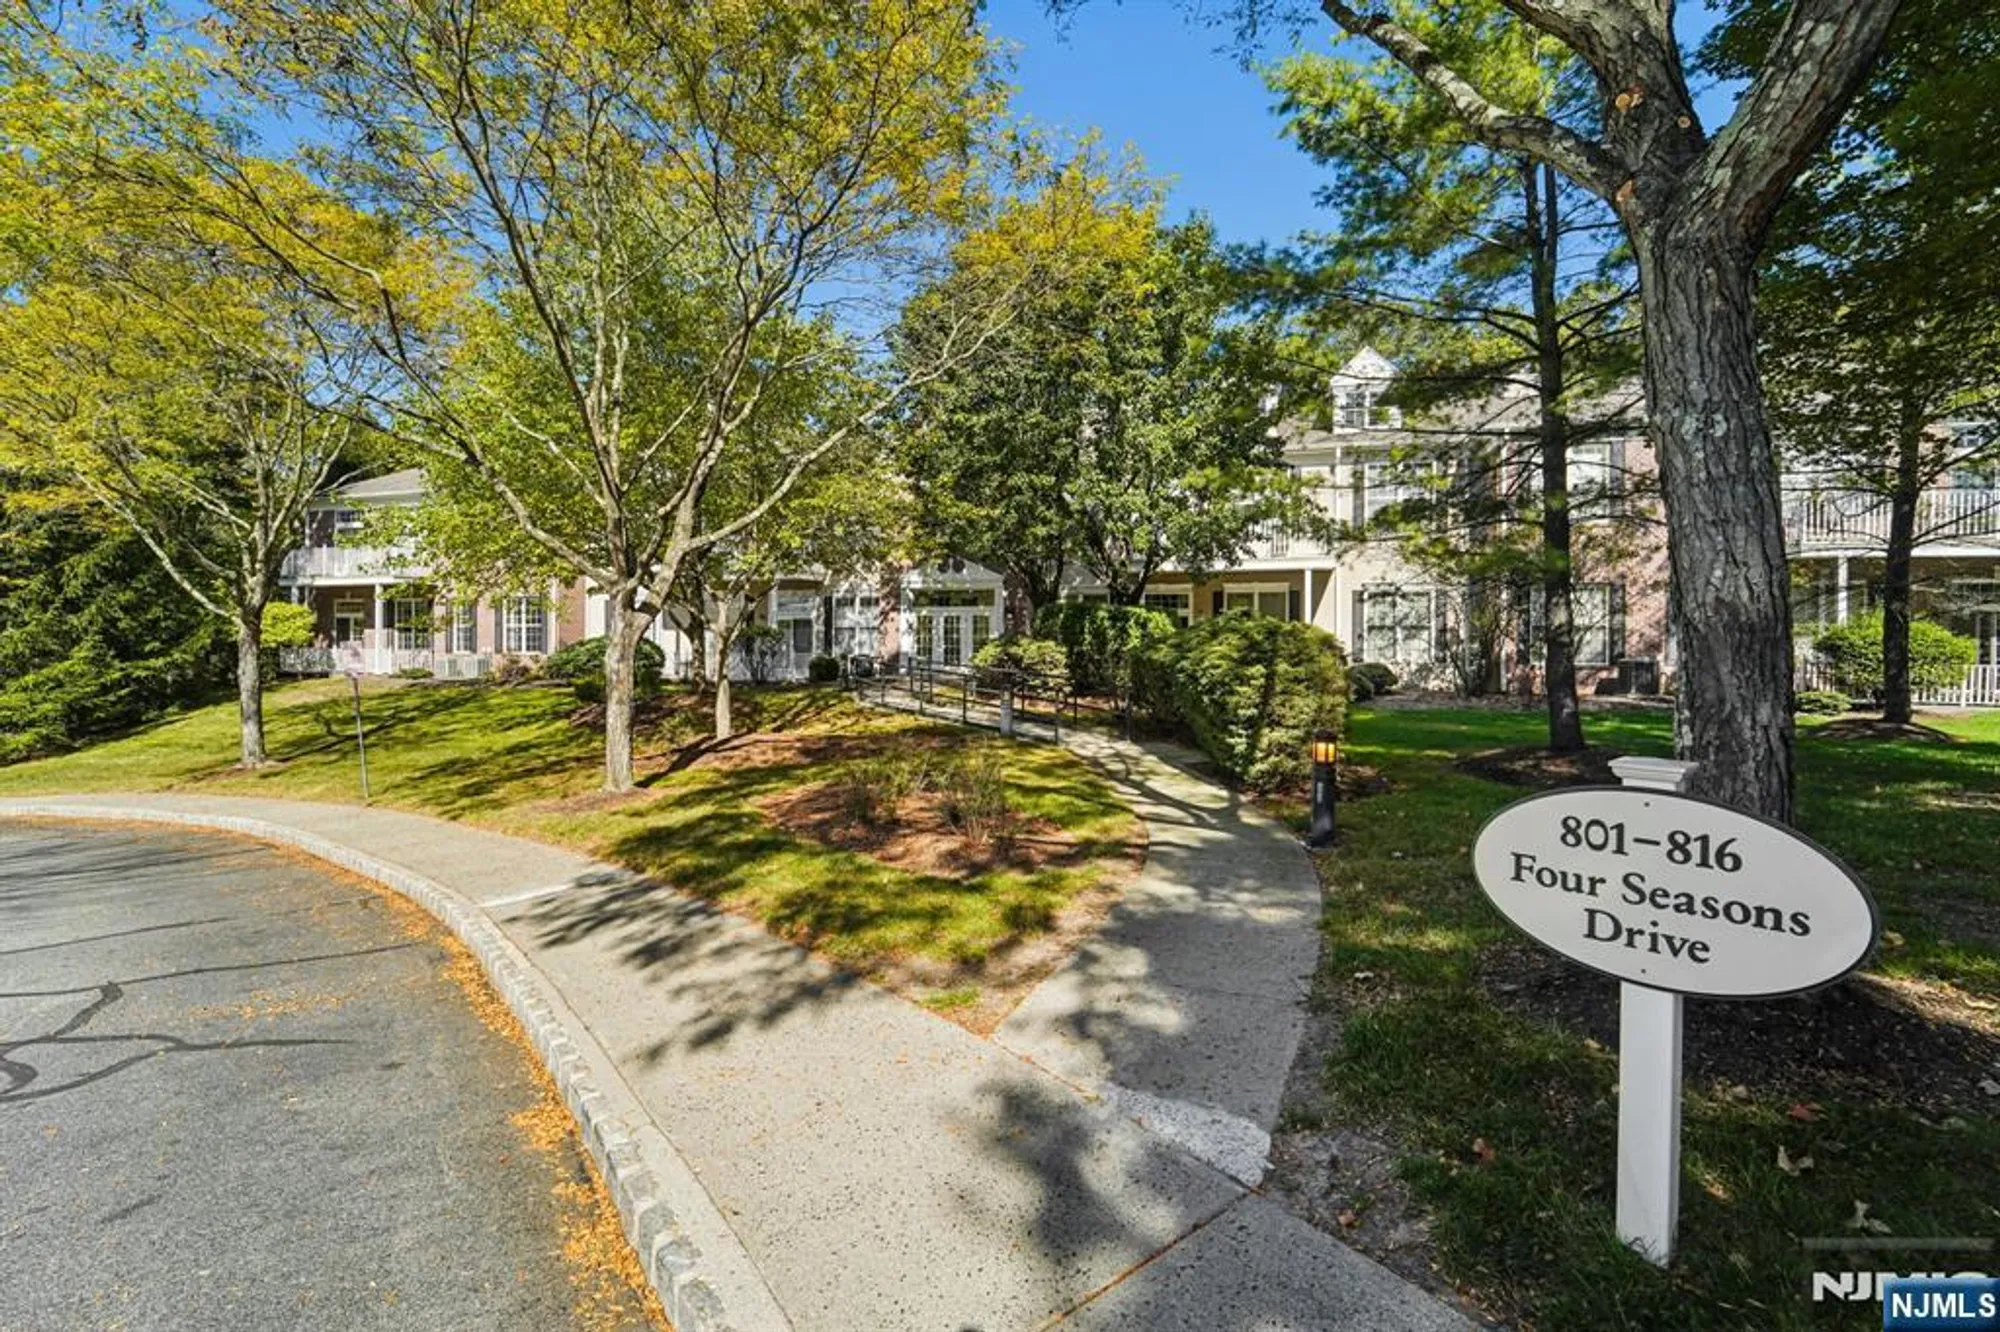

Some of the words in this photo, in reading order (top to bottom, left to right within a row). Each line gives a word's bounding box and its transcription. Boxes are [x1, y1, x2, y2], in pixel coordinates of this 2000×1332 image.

[1510, 851, 1607, 898] Four
[1621, 871, 1811, 937] Seasons
[1583, 907, 1711, 965] Drive
